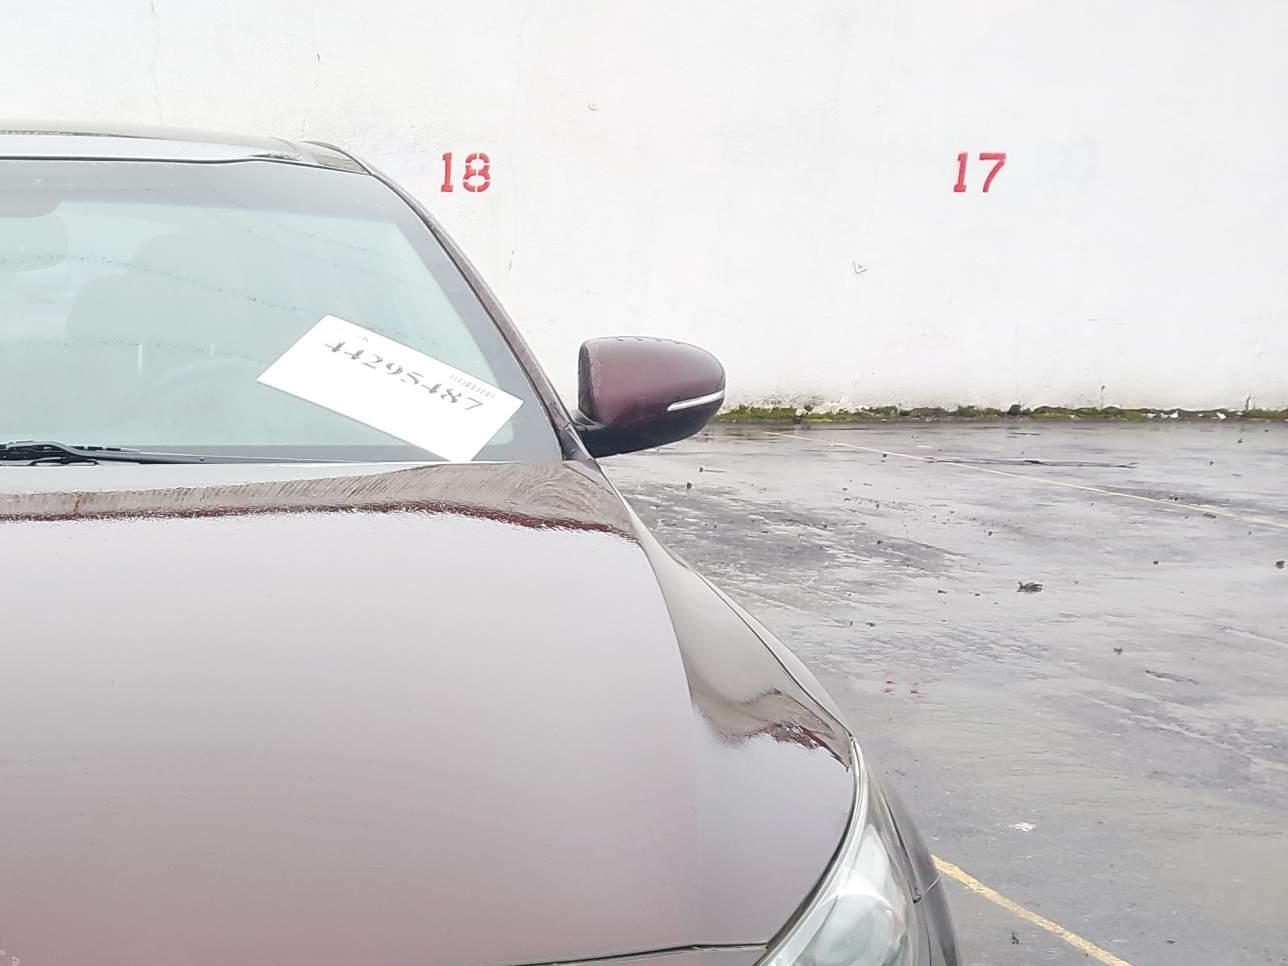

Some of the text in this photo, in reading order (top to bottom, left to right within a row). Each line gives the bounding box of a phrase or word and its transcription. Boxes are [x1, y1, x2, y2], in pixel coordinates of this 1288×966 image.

[440, 152, 491, 193] 18
[952, 152, 1007, 193] 17
[324, 341, 484, 411] 44295487
